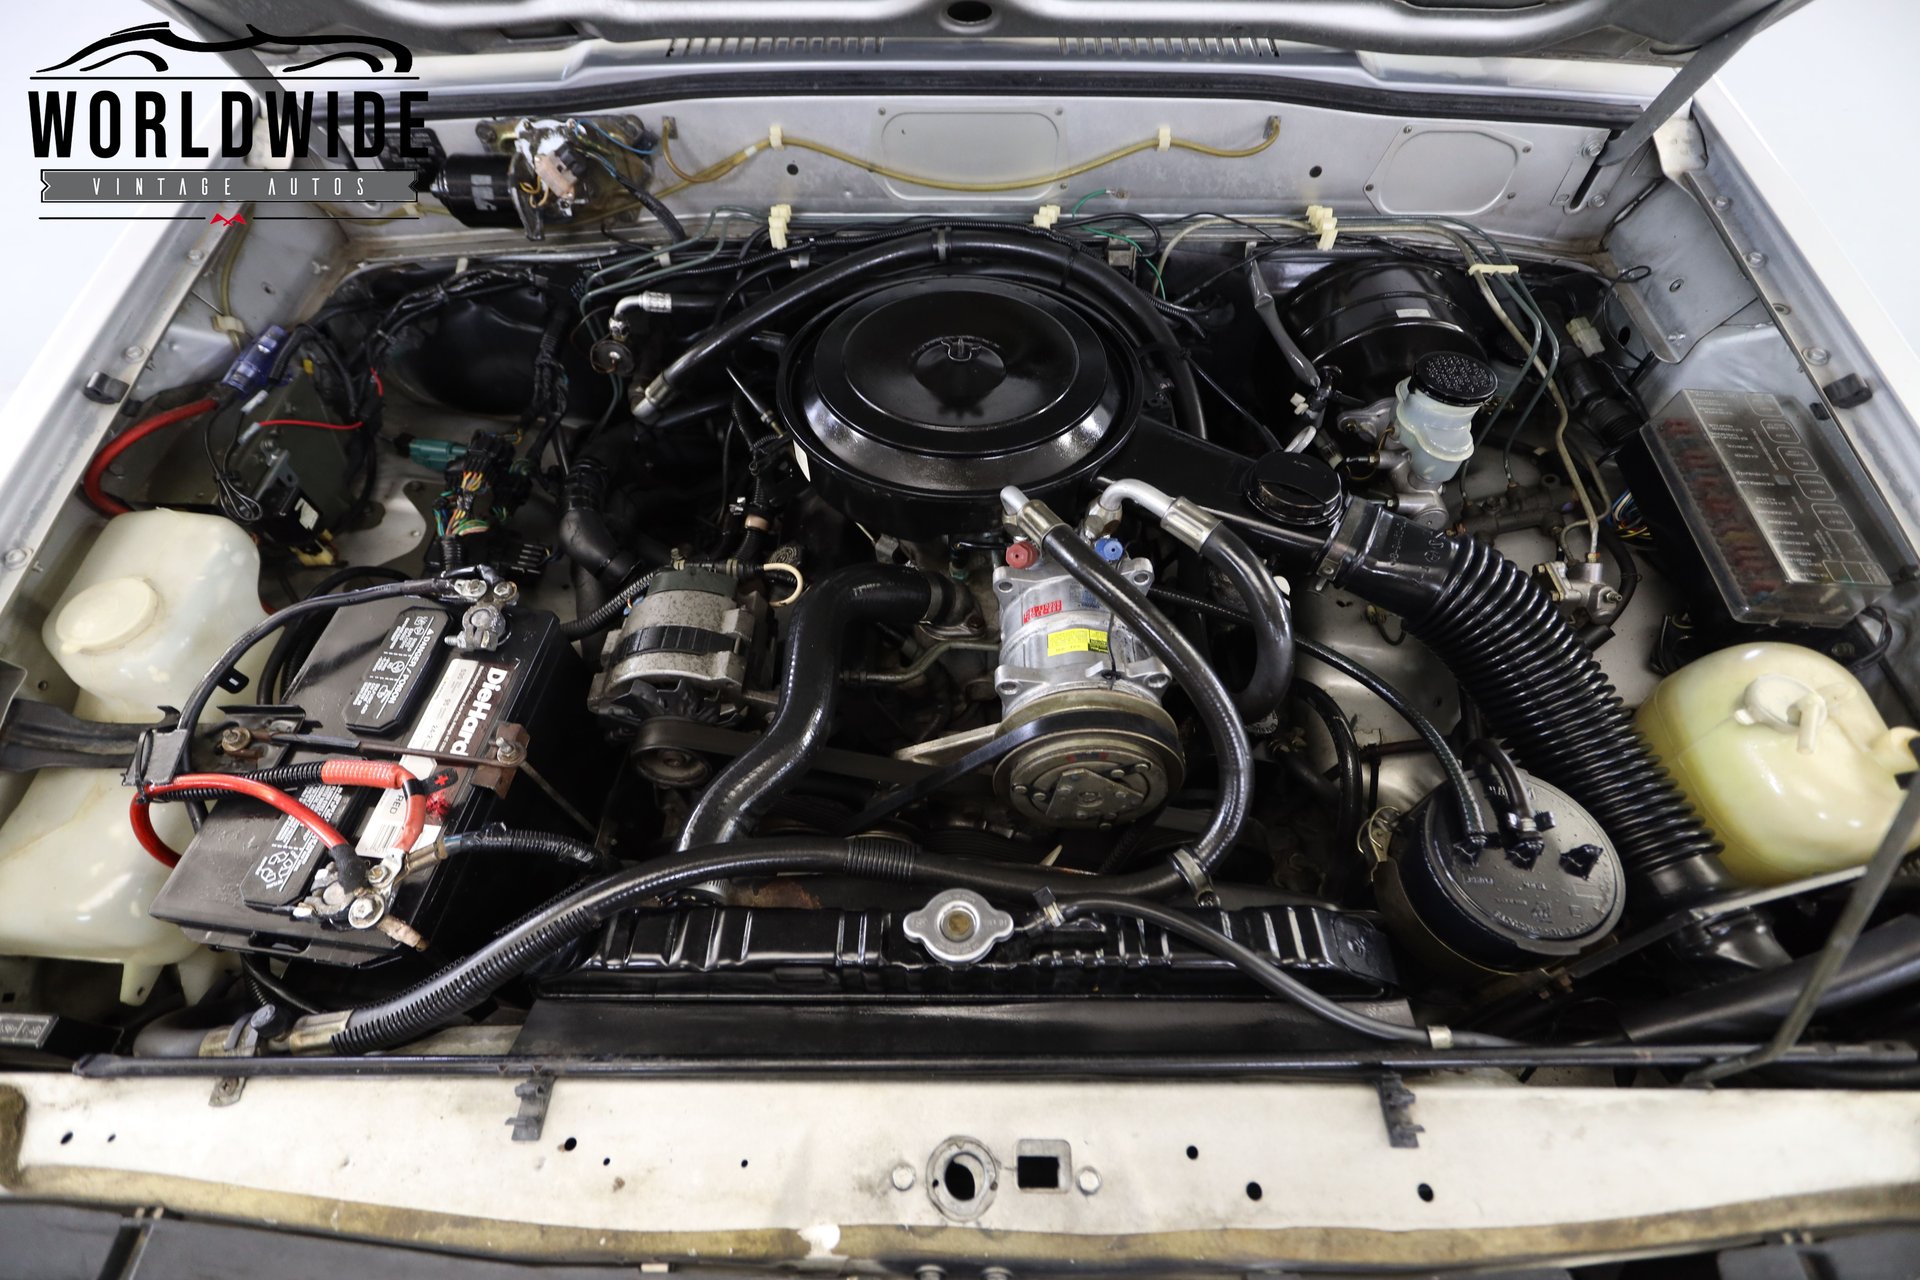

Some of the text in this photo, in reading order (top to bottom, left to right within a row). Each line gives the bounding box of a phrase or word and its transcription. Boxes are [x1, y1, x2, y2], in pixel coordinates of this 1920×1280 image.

[409, 636, 430, 667] DANGER
[388, 674, 409, 704] POISON
[450, 667, 508, 756] DieHard
[390, 795, 404, 814] RED
